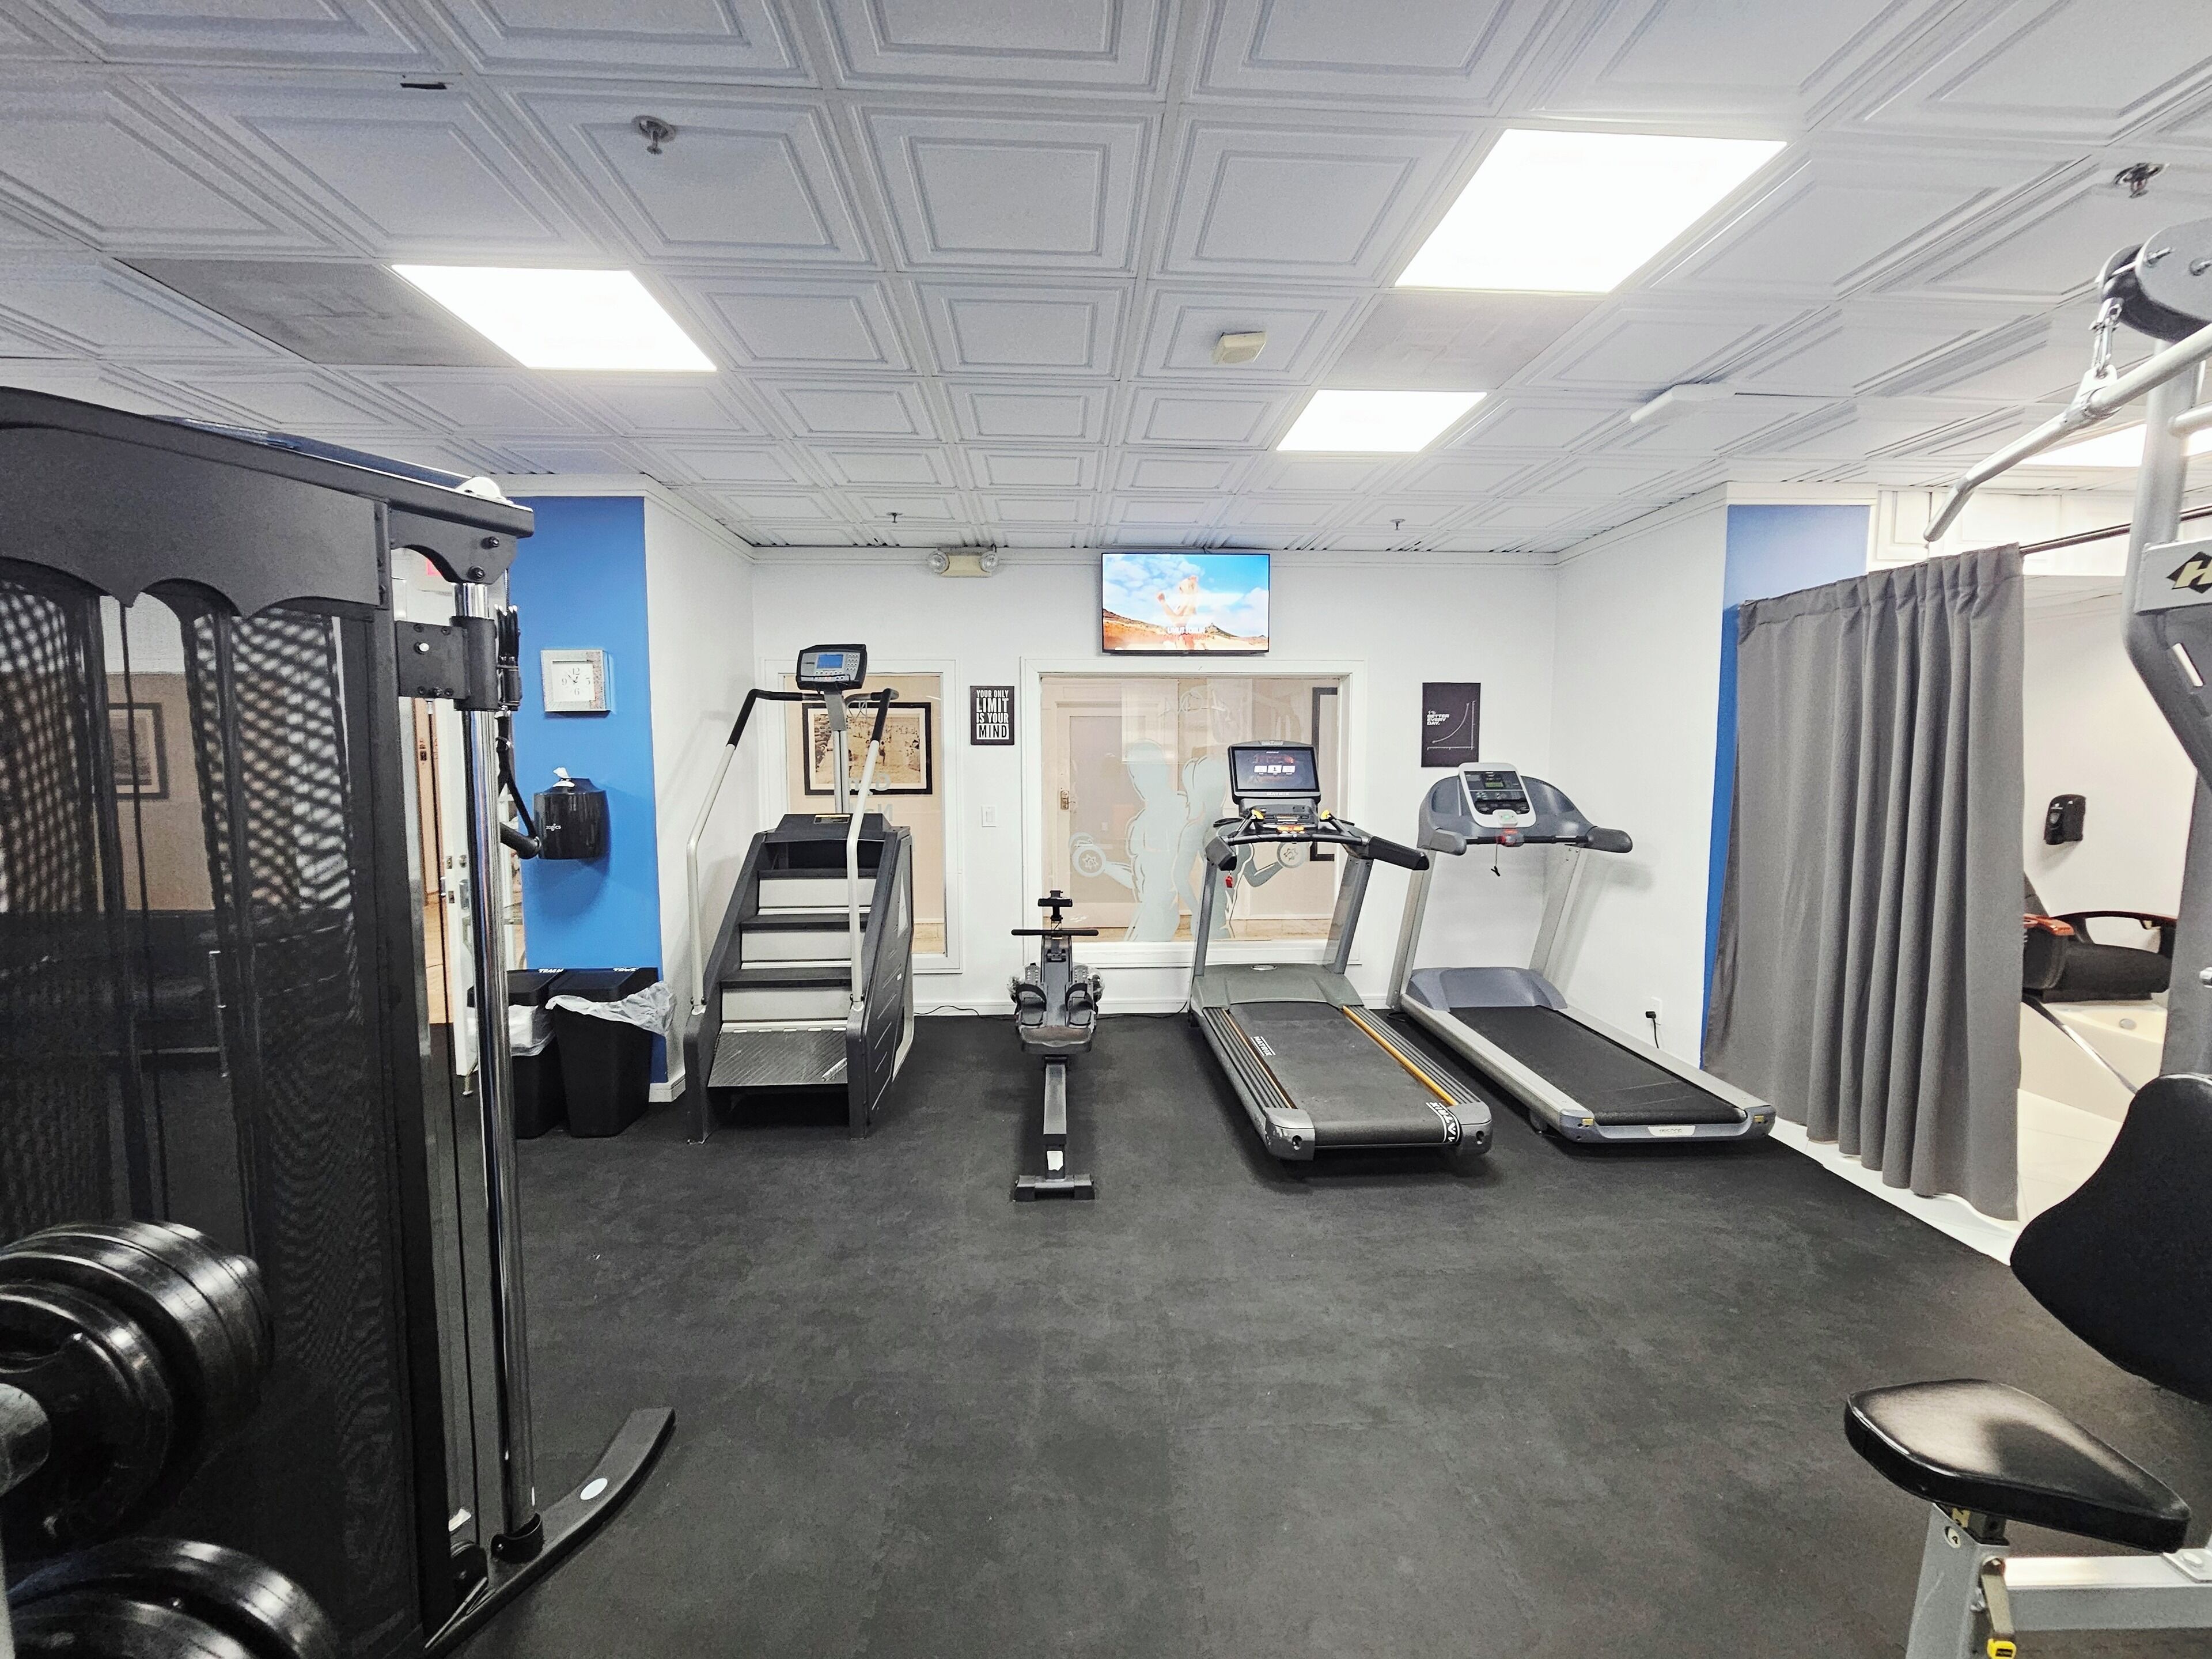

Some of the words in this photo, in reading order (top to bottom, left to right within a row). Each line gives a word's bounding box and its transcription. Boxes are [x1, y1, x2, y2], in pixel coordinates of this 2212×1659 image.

[562, 678, 567, 686] 9
[574, 687, 580, 696] 6
[976, 698, 1009, 713] LIMIT
[976, 713, 984, 723] IS
[987, 713, 1009, 723] YOUR
[979, 725, 1007, 738] MIND
[1253, 1036, 1272, 1056] MATRIX
